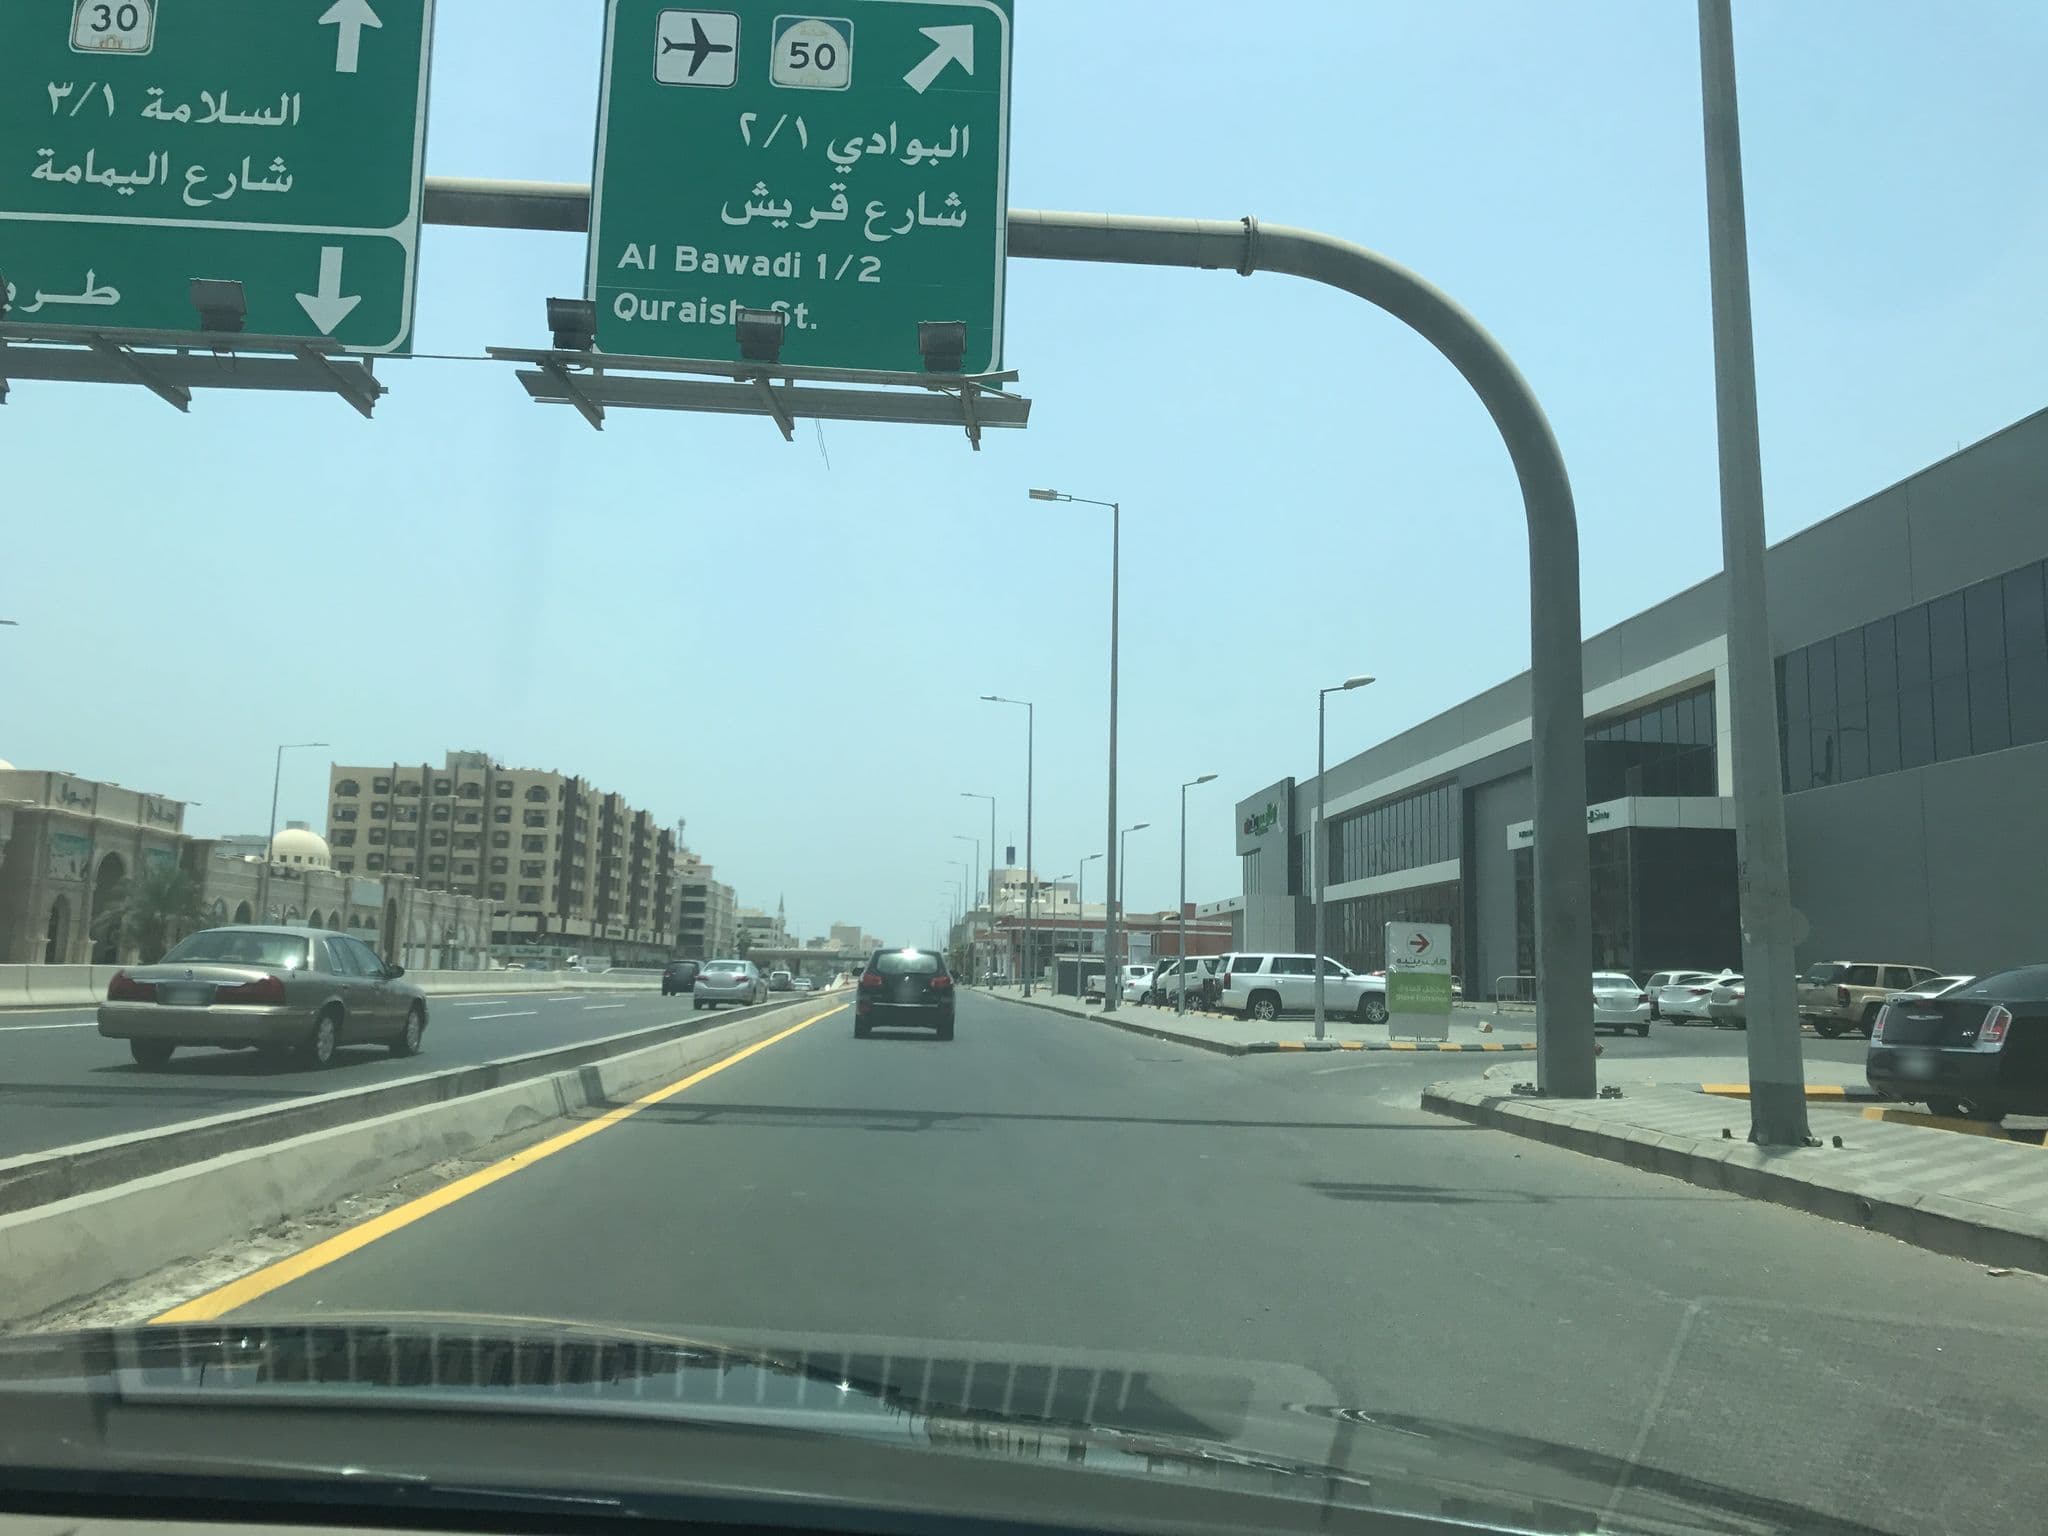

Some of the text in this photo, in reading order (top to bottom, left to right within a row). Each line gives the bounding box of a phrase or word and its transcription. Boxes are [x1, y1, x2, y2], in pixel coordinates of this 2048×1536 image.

[90, 3, 139, 32] 30
[788, 41, 836, 71] 50
[140, 86, 301, 126] السلامة
[826, 120, 970, 174] البوادي
[31, 148, 294, 207] شارع اليمامة
[720, 181, 968, 242] شارع قريش
[617, 243, 882, 283] Al Bawadi 1/2
